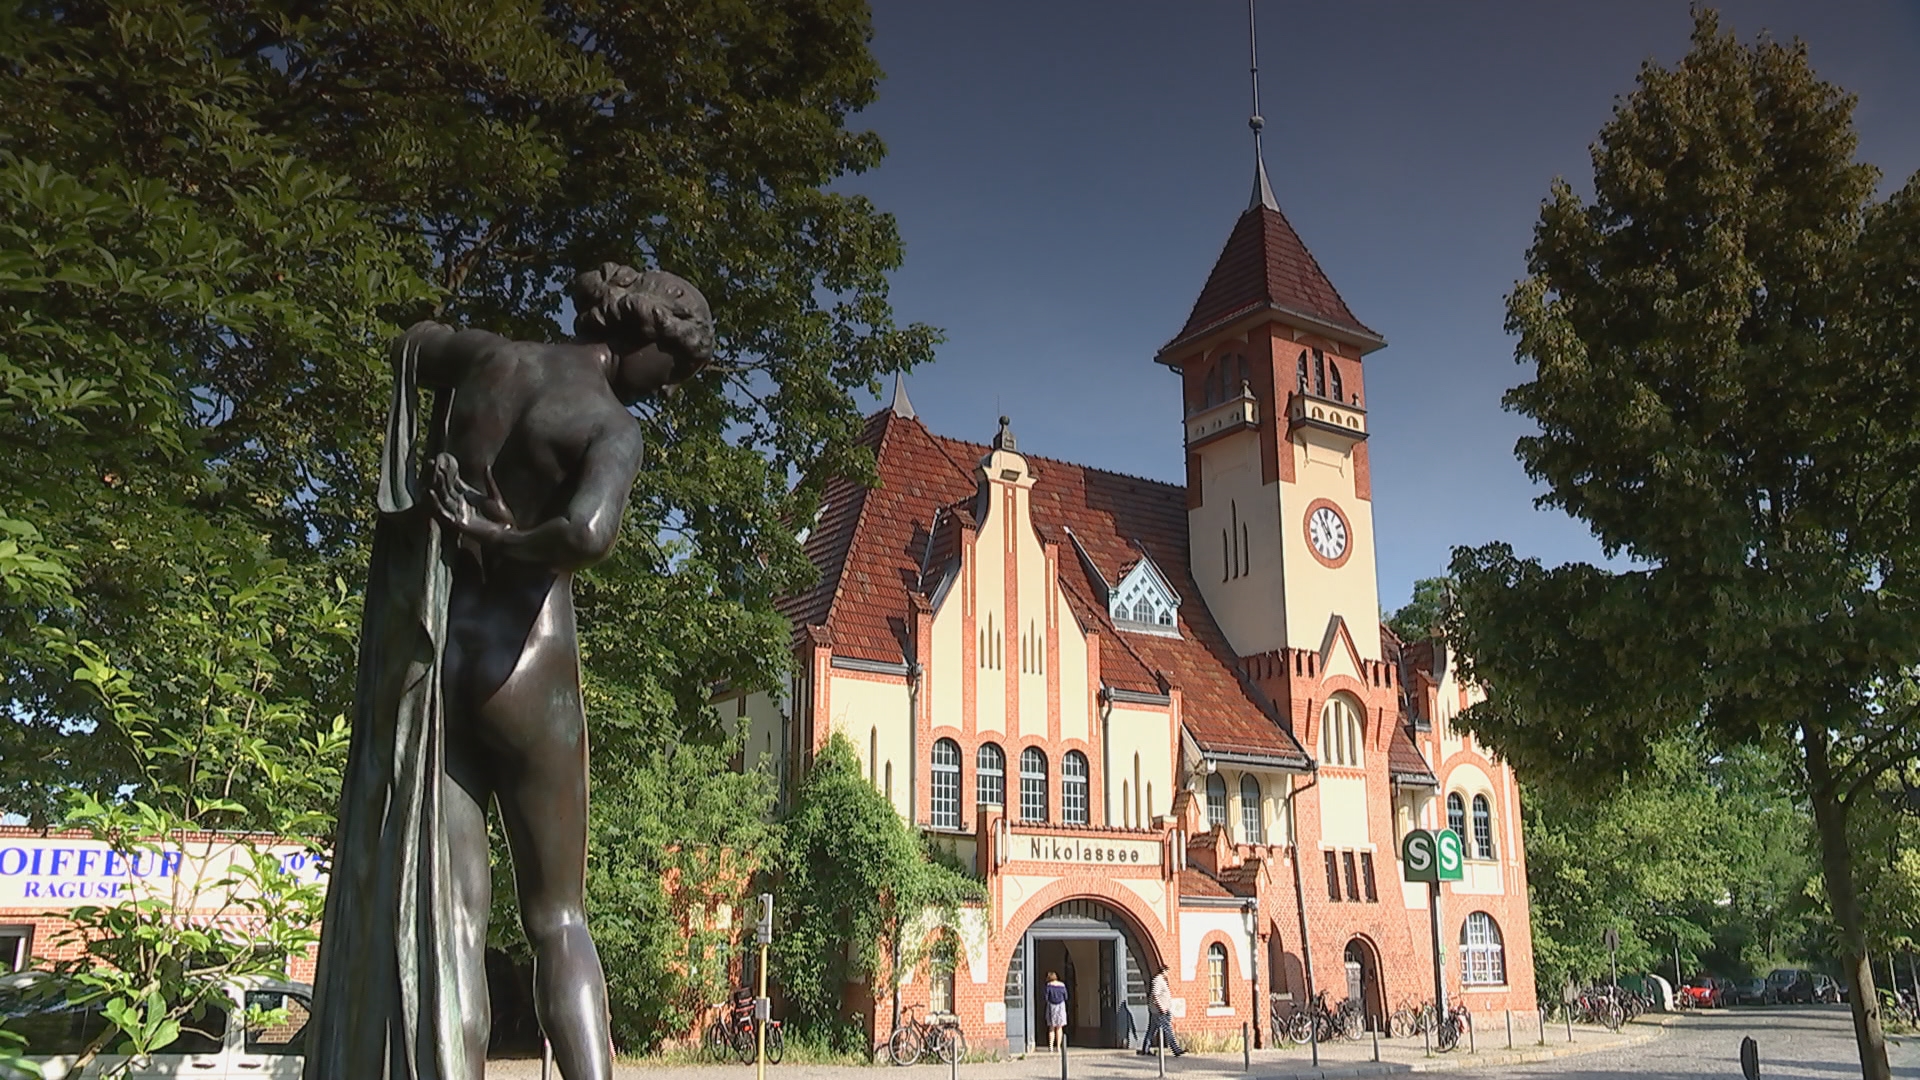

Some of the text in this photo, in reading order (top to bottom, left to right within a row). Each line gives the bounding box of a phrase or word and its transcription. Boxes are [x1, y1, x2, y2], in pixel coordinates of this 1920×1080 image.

[1031, 838, 1139, 863] Nikolassee
[1408, 837, 1431, 871] S
[1440, 836, 1459, 871] S
